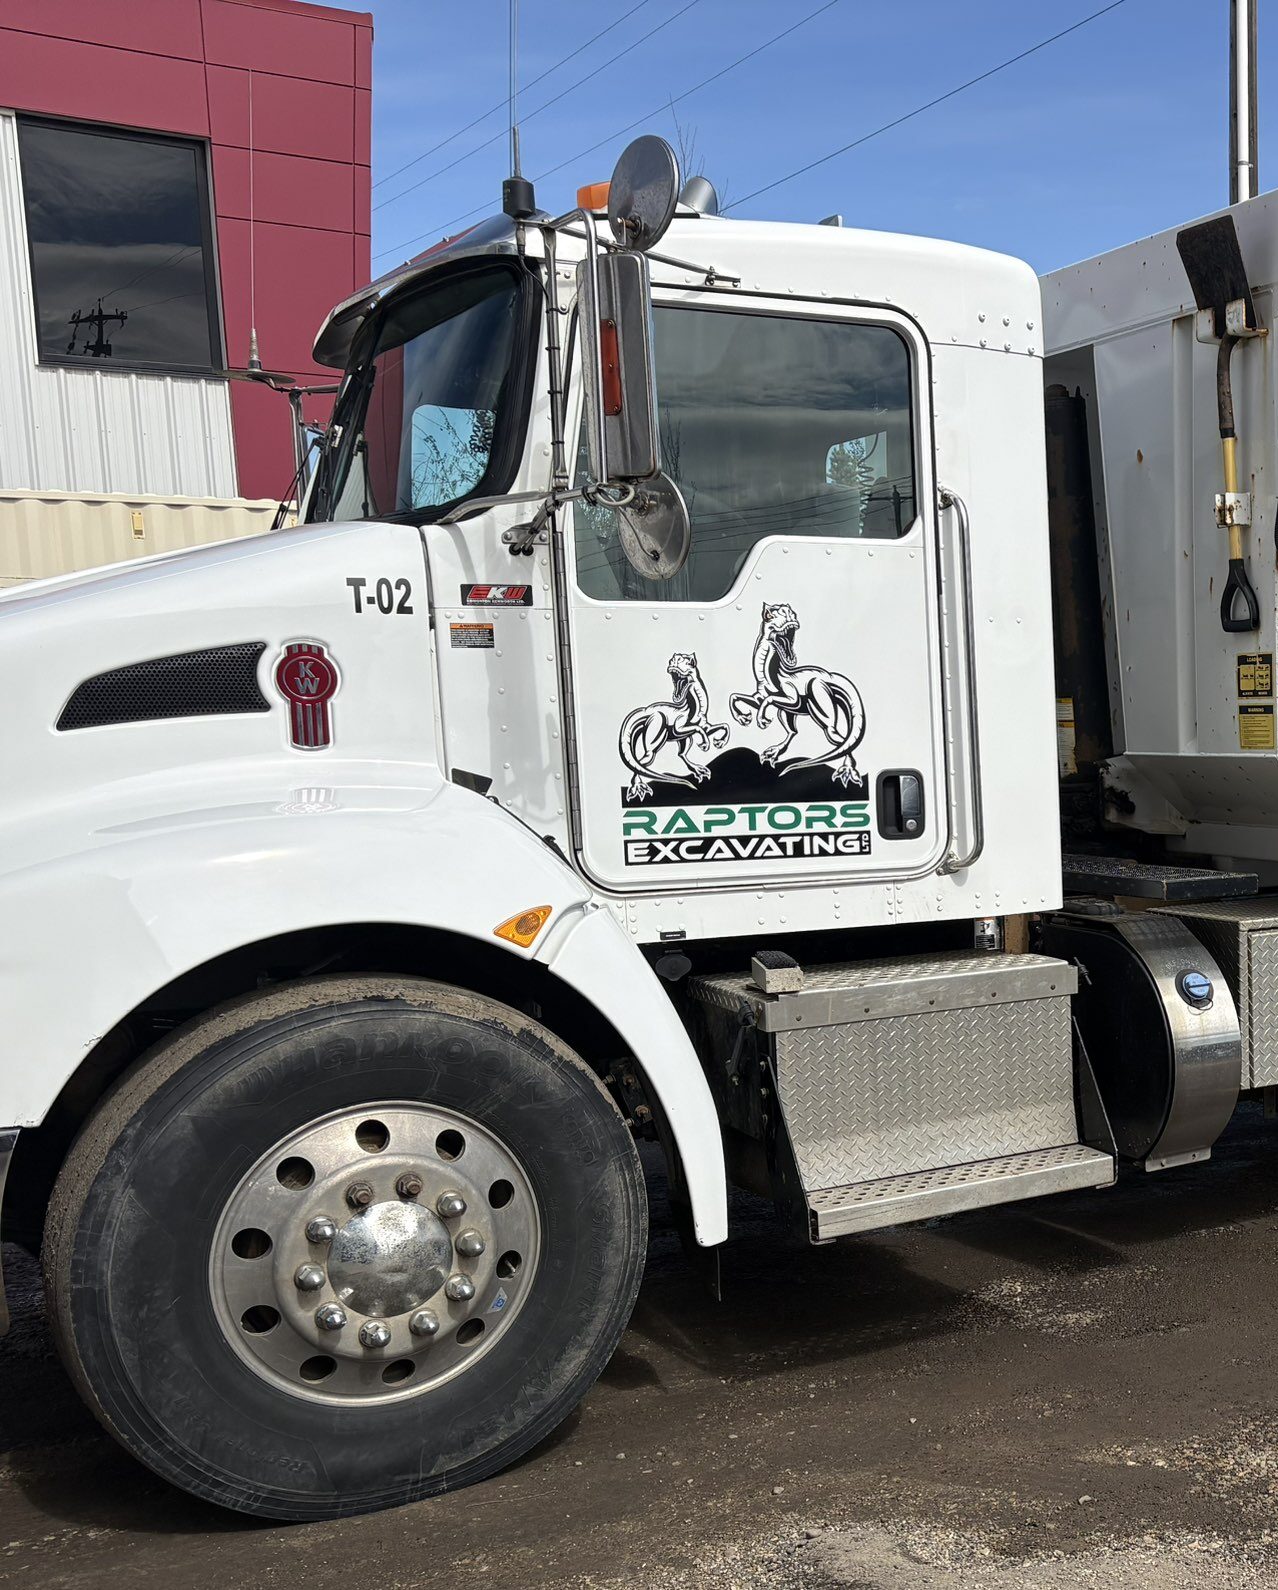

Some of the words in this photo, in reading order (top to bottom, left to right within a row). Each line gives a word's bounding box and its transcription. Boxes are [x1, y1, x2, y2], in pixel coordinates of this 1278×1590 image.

[346, 577, 414, 615] T-02
[467, 586, 527, 599] EKW
[623, 804, 871, 835] RAPTORS
[626, 833, 860, 864] EXCAVATING
[861, 833, 870, 853] LTD
